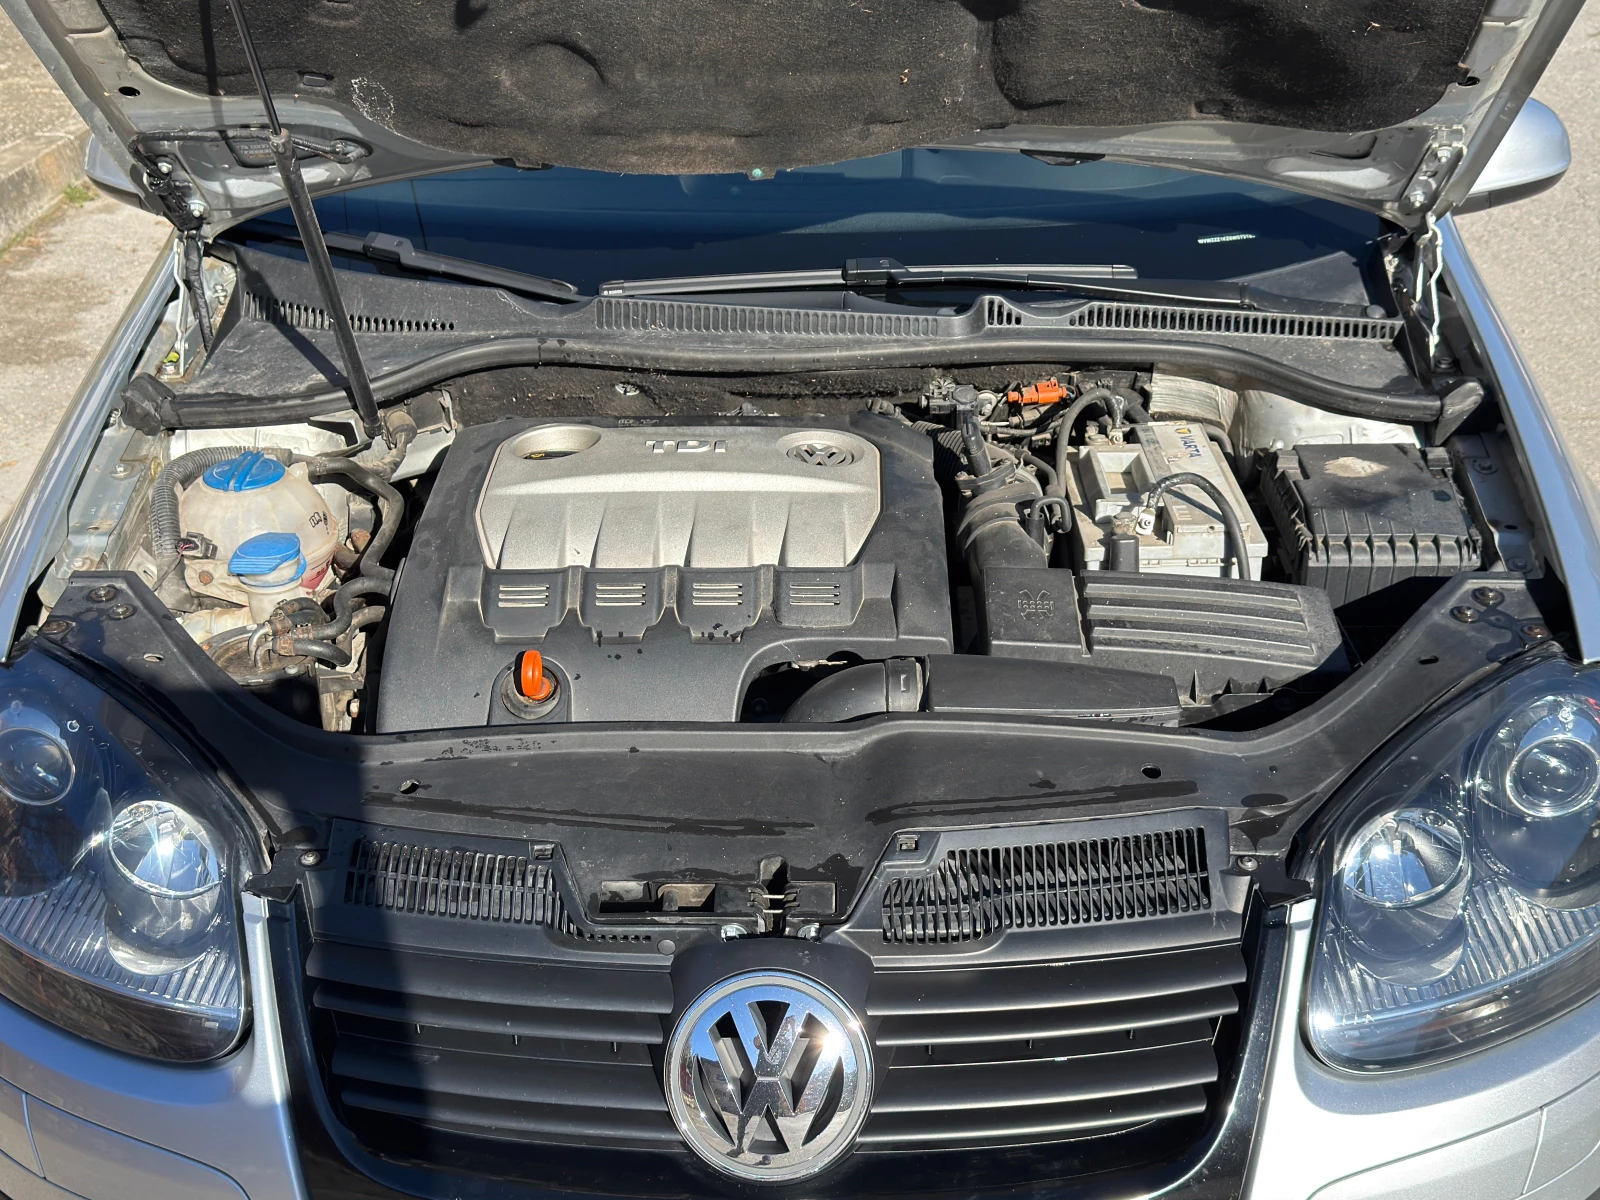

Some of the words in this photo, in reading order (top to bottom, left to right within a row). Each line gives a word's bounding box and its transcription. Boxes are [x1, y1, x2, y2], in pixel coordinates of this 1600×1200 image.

[645, 440, 728, 454] TDI
[1179, 434, 1202, 459] VARTA
[676, 979, 862, 1173] VW
